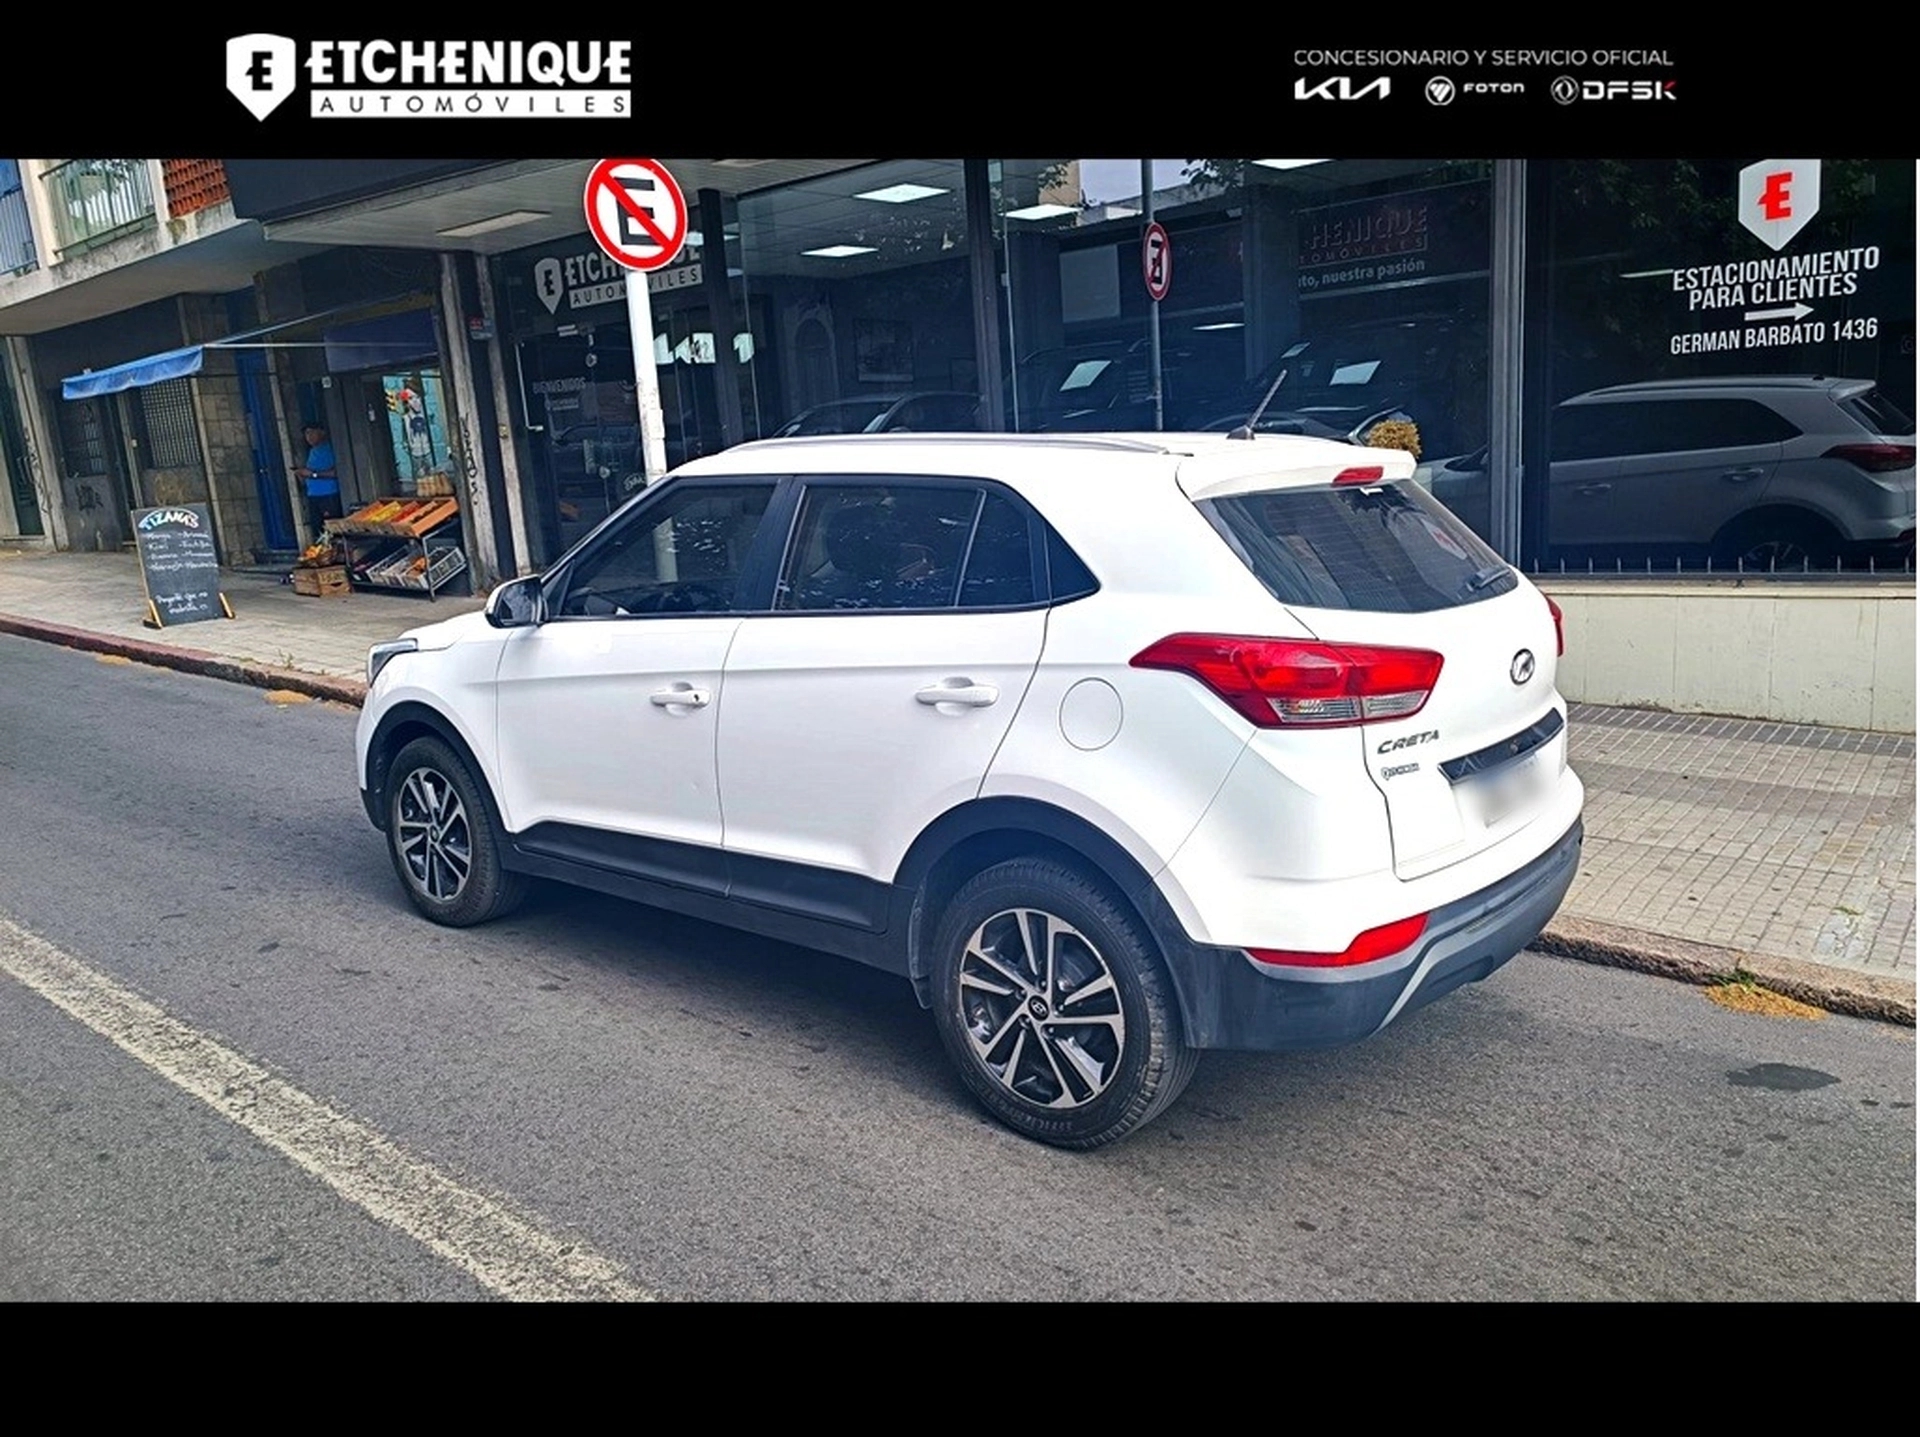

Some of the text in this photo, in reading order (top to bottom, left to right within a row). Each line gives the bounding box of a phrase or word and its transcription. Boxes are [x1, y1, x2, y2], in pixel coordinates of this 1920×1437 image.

[1322, 267, 1375, 285] nuestra
[1377, 258, 1426, 280] pasión
[1672, 246, 1880, 291] ESTACIONAMIENTO
[1689, 272, 1858, 311] PARA CLIENTES
[1670, 317, 1879, 355] GERMAN BARBATO 1436
[1377, 729, 1440, 754] CRETA
